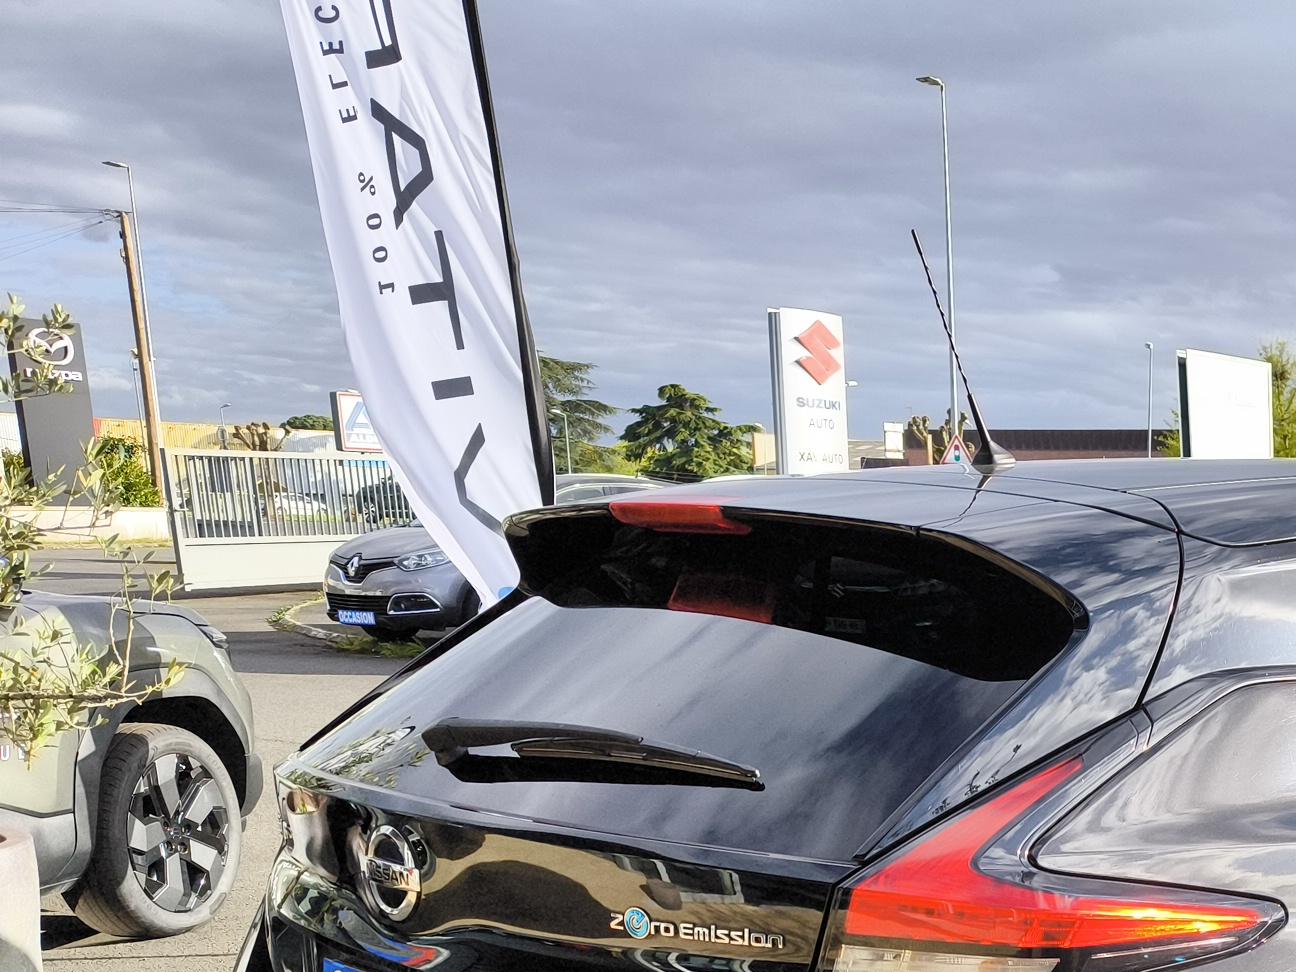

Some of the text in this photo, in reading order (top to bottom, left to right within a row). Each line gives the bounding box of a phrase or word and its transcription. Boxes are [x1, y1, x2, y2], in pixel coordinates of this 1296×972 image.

[796, 396, 841, 411] SUZUKI
[808, 418, 835, 430] AUTO
[338, 609, 376, 625] OCCASION
[679, 922, 784, 949] Emission
